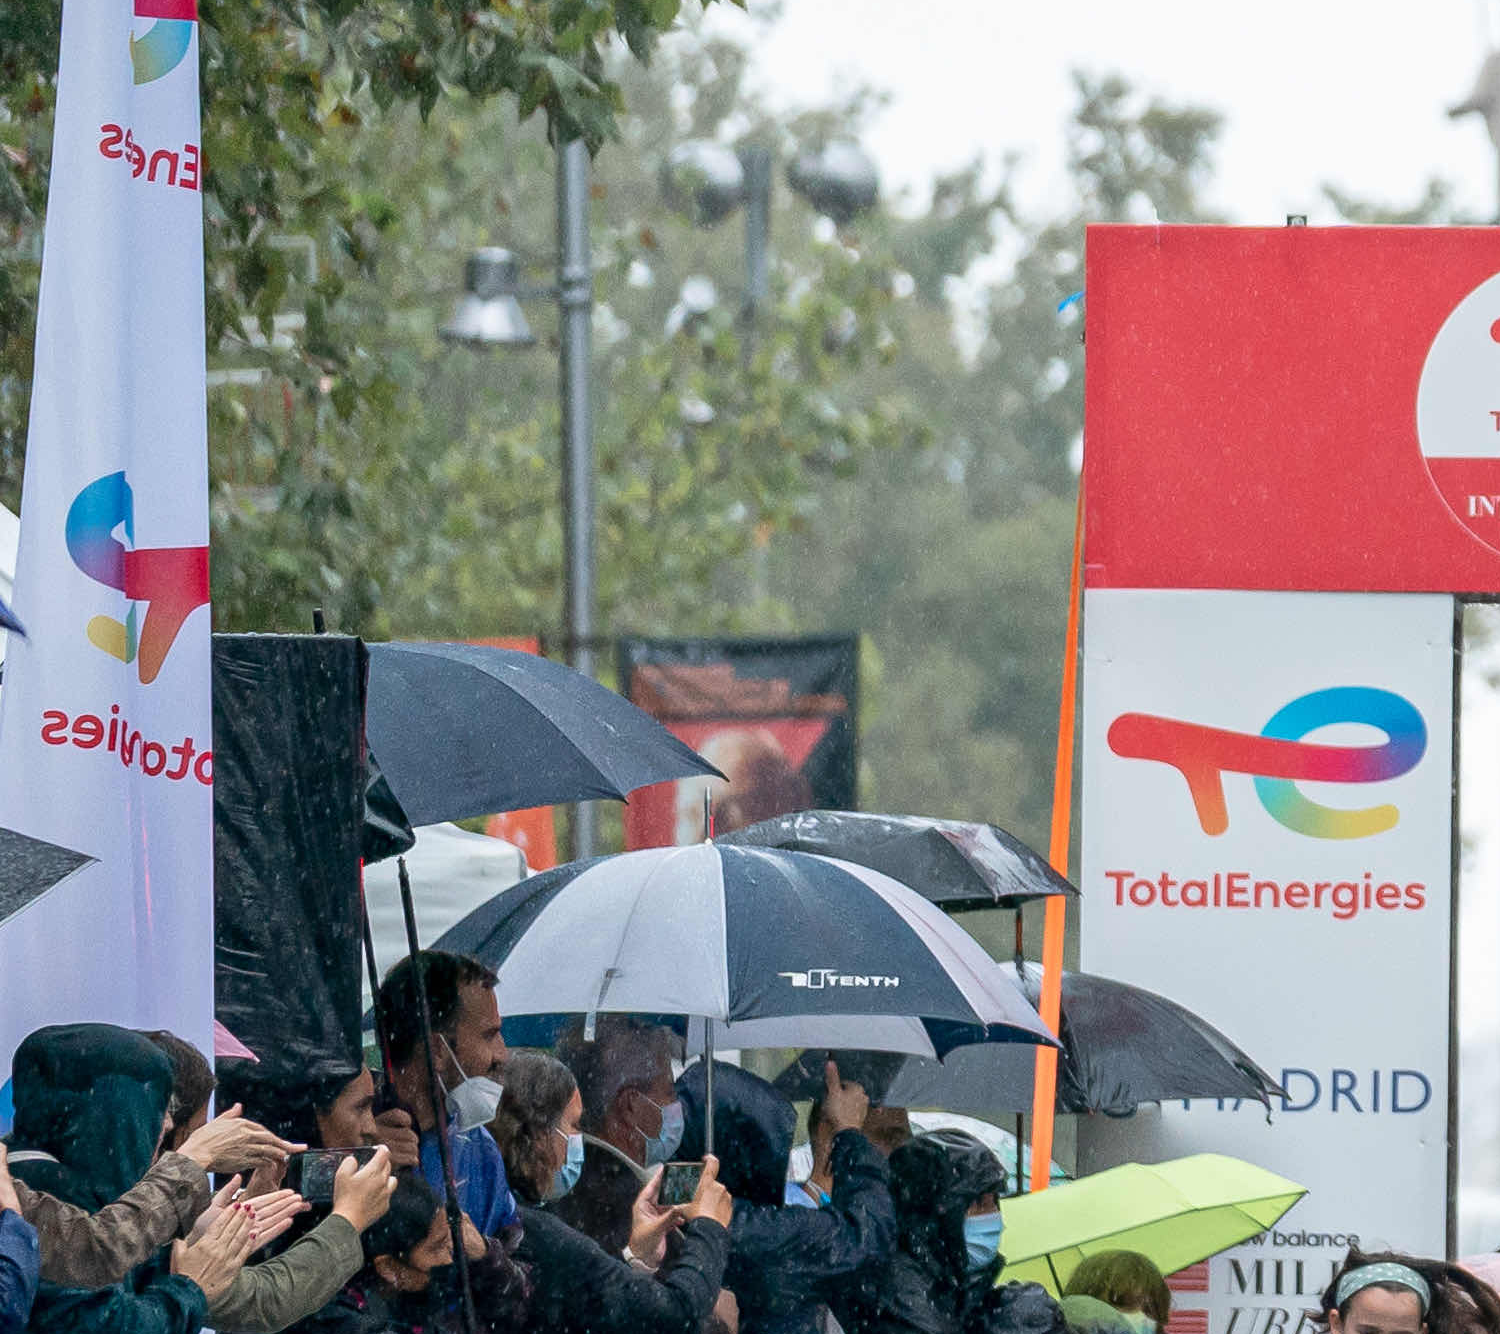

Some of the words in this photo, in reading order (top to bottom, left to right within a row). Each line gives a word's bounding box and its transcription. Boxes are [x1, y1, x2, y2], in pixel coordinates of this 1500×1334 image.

[1104, 870, 1426, 921] TotalEnergies
[1273, 1232, 1358, 1247] balance
[1226, 1258, 1340, 1296] MIL
